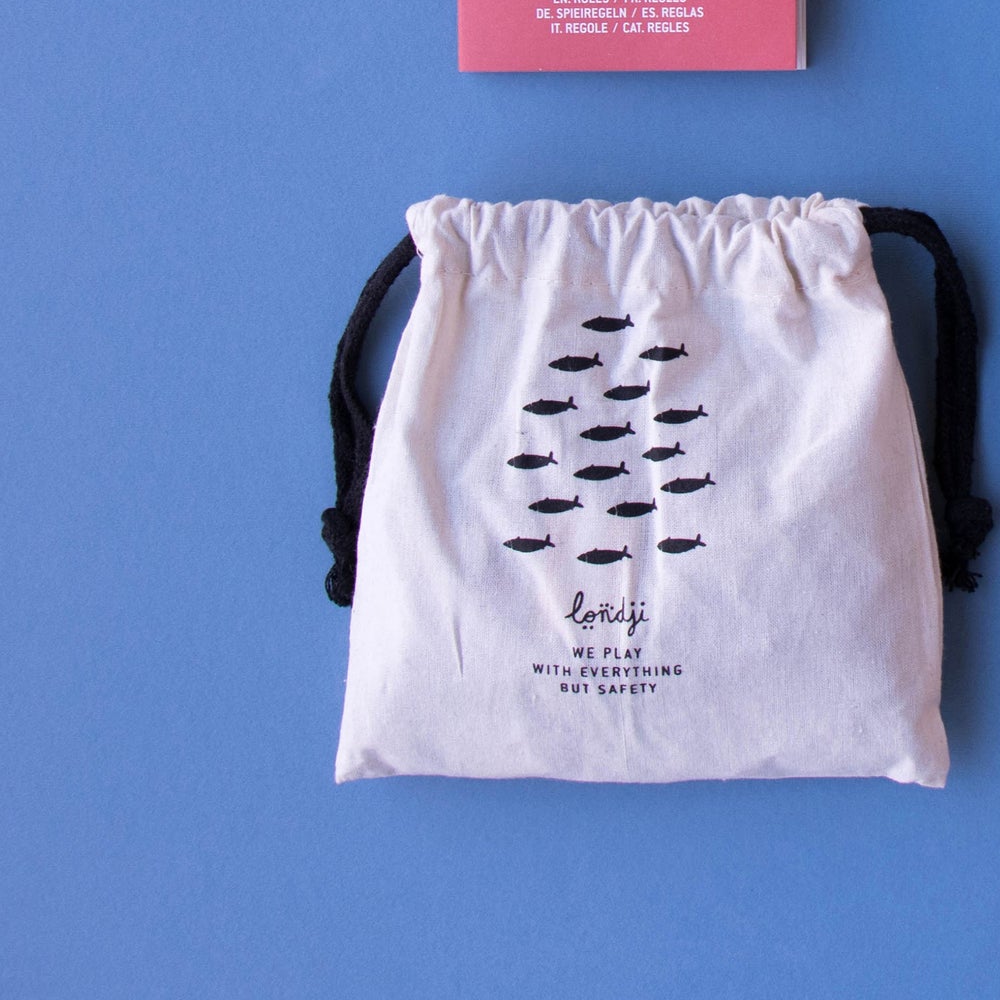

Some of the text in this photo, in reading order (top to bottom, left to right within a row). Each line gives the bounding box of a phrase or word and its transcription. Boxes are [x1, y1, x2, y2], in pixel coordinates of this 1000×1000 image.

[536, 8, 554, 19] DE.
[641, 7, 659, 18] ES.
[661, 7, 704, 18] REGLAS
[551, 23, 563, 34] IT.
[565, 22, 608, 33] REGOLE
[622, 22, 644, 33] CAT.
[647, 22, 690, 32] REGLES
[573, 647, 642, 659] WE PLAY
[533, 663, 683, 677] WITH EVERYTHING
[560, 683, 657, 694] BUT SAFETY
